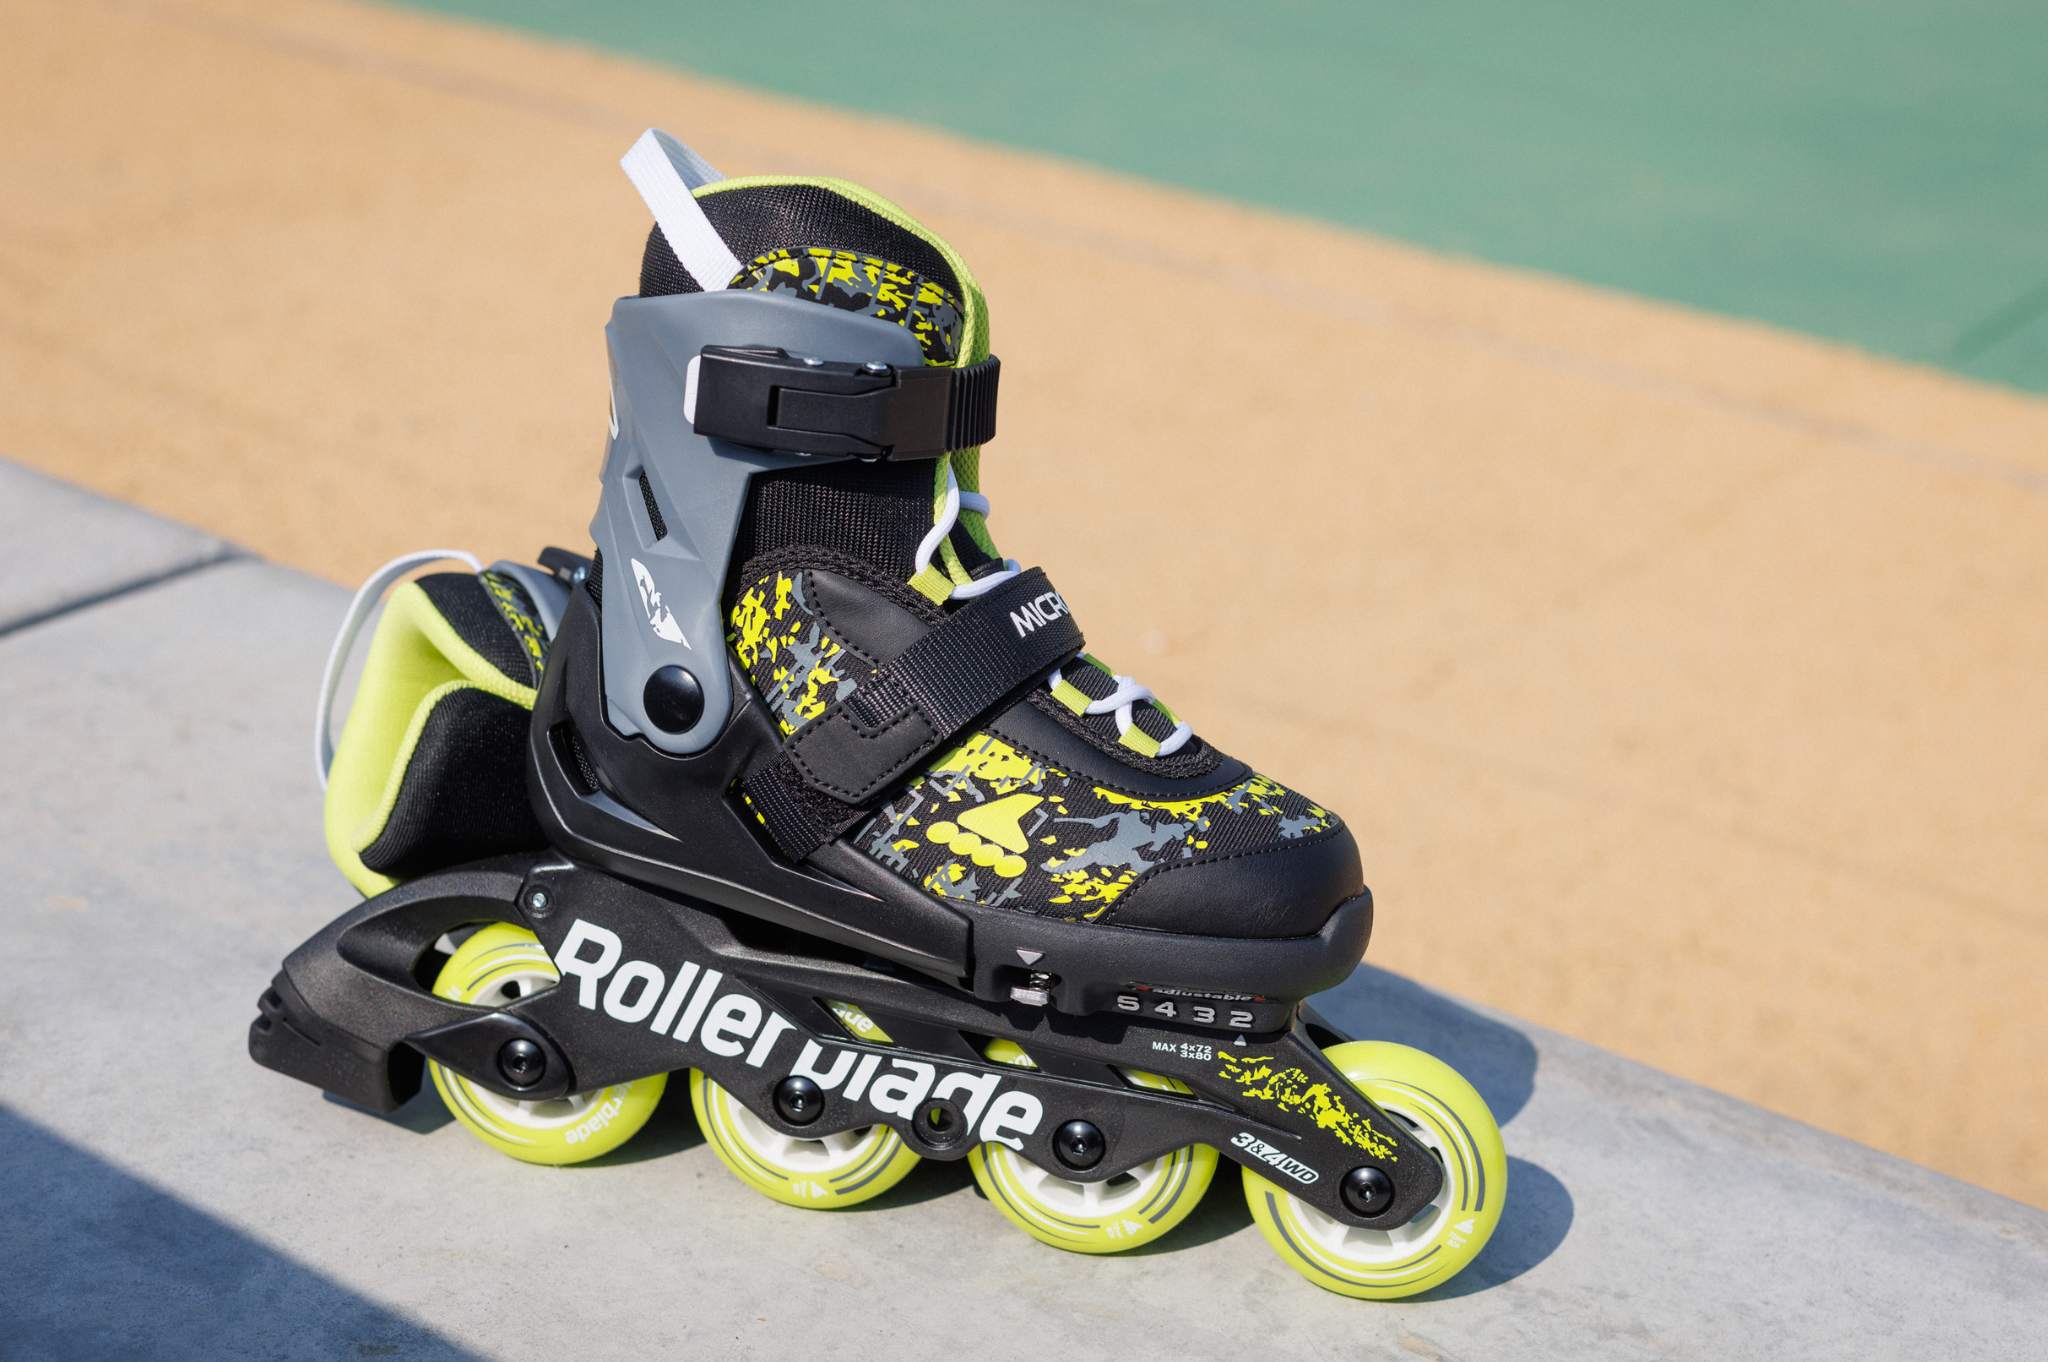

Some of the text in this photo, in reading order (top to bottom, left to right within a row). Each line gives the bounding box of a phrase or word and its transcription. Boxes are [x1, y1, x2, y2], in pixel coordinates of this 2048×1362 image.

[1010, 591, 1069, 638] MICR
[1154, 1001, 1177, 1017] 4
[1193, 1006, 1215, 1023] 3
[1229, 1010, 1253, 1028] 2
[1152, 1041, 1177, 1053] MAX
[1180, 1042, 1212, 1053] 4x72
[1180, 1049, 1212, 1061] 3x80
[1231, 1132, 1318, 1184] 3&4WD
